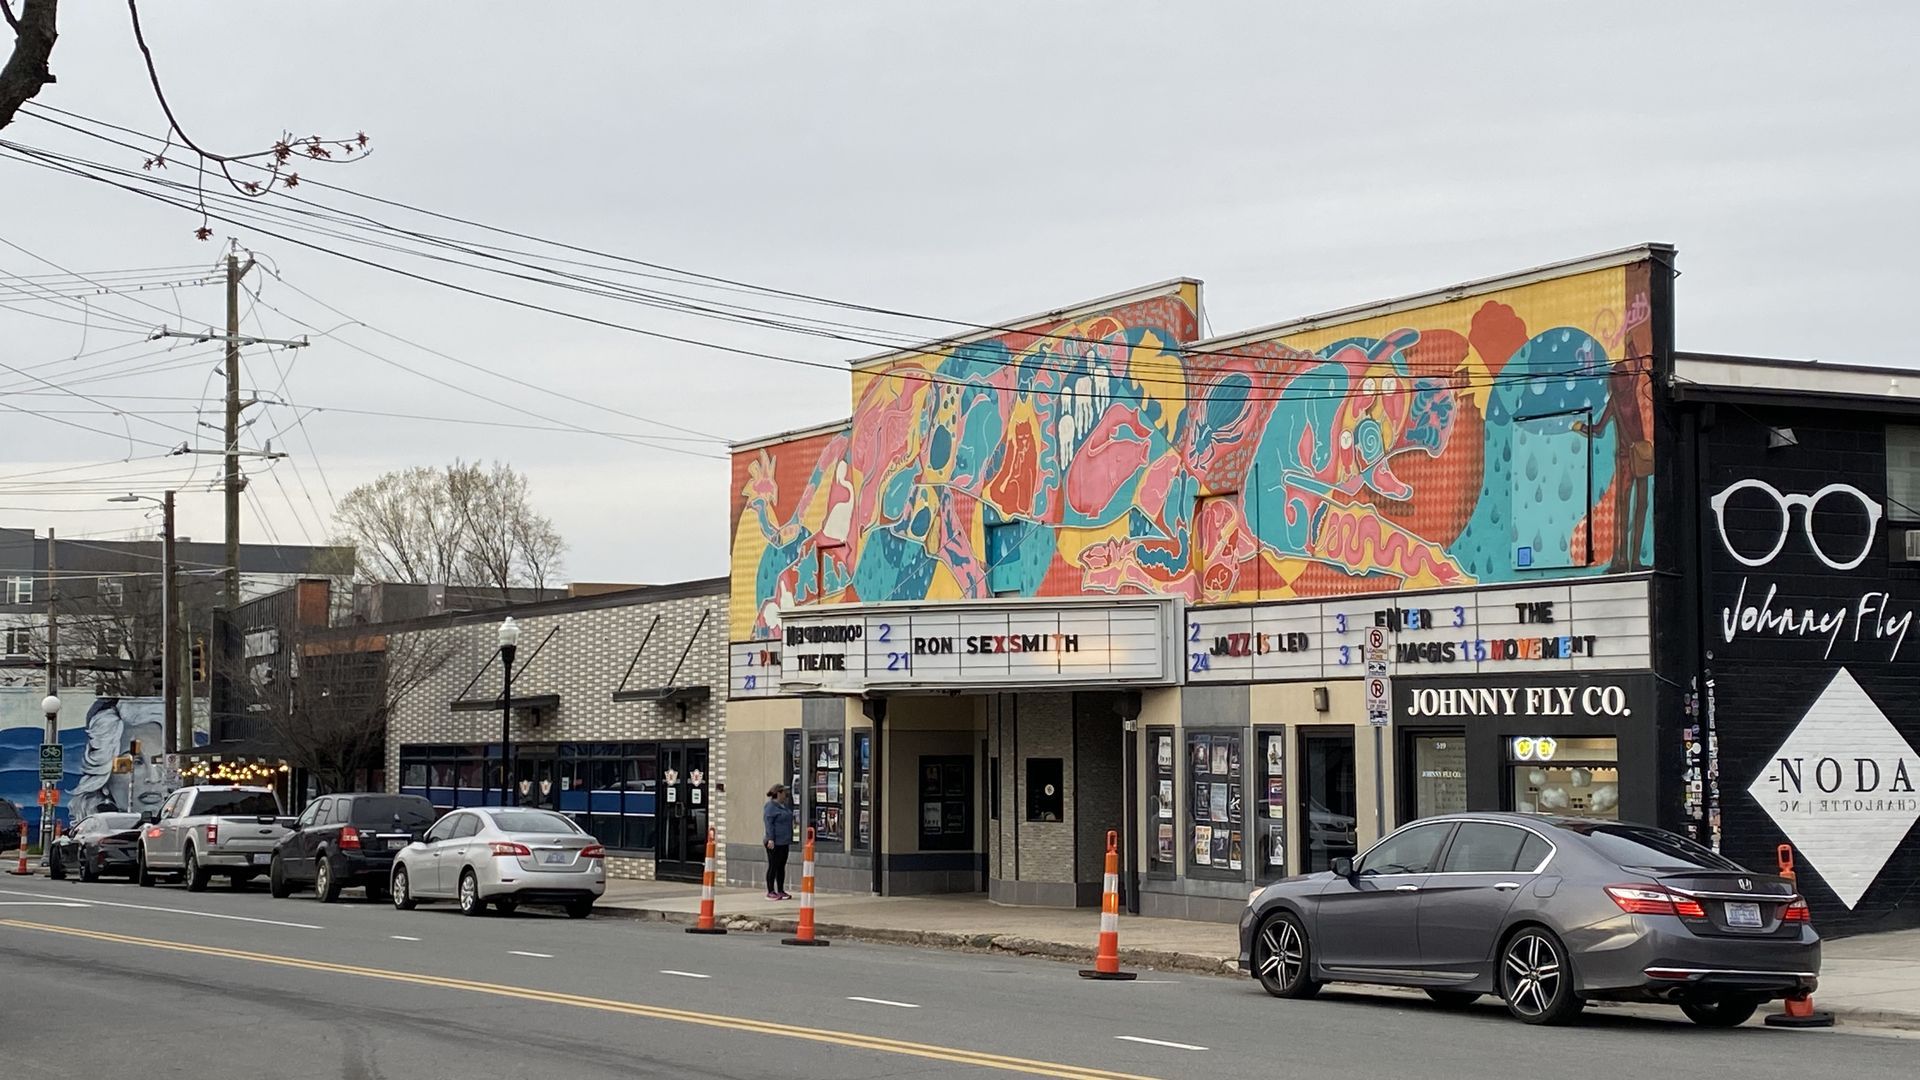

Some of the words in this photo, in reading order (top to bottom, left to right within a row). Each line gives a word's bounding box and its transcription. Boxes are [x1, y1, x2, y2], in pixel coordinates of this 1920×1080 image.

[1335, 613, 1347, 634] 3
[1374, 607, 1433, 632] ENTER
[1452, 605, 1465, 628] 3
[1515, 601, 1554, 624] THE
[1723, 576, 1847, 660] Johnny
[1854, 592, 1913, 662] Fly
[878, 623, 891, 642] 2
[914, 636, 953, 654] RON
[966, 633, 1079, 654] SEXSMITH
[1190, 622, 1201, 642] 2
[1210, 632, 1251, 657] JAZZ
[1256, 631, 1271, 656] IS
[1278, 632, 1310, 653] LED
[1338, 644, 1350, 666] 3
[1397, 641, 1456, 664] HAGGIS
[1460, 638, 1487, 662] 15
[1491, 635, 1597, 661] MOVEMENT
[887, 651, 910, 671] 21
[1191, 652, 1211, 673] 24
[1407, 687, 1520, 716] JOHNNY
[1525, 687, 1578, 716] FLY
[1582, 685, 1632, 717] CO.
[1777, 757, 1916, 794] NODA
